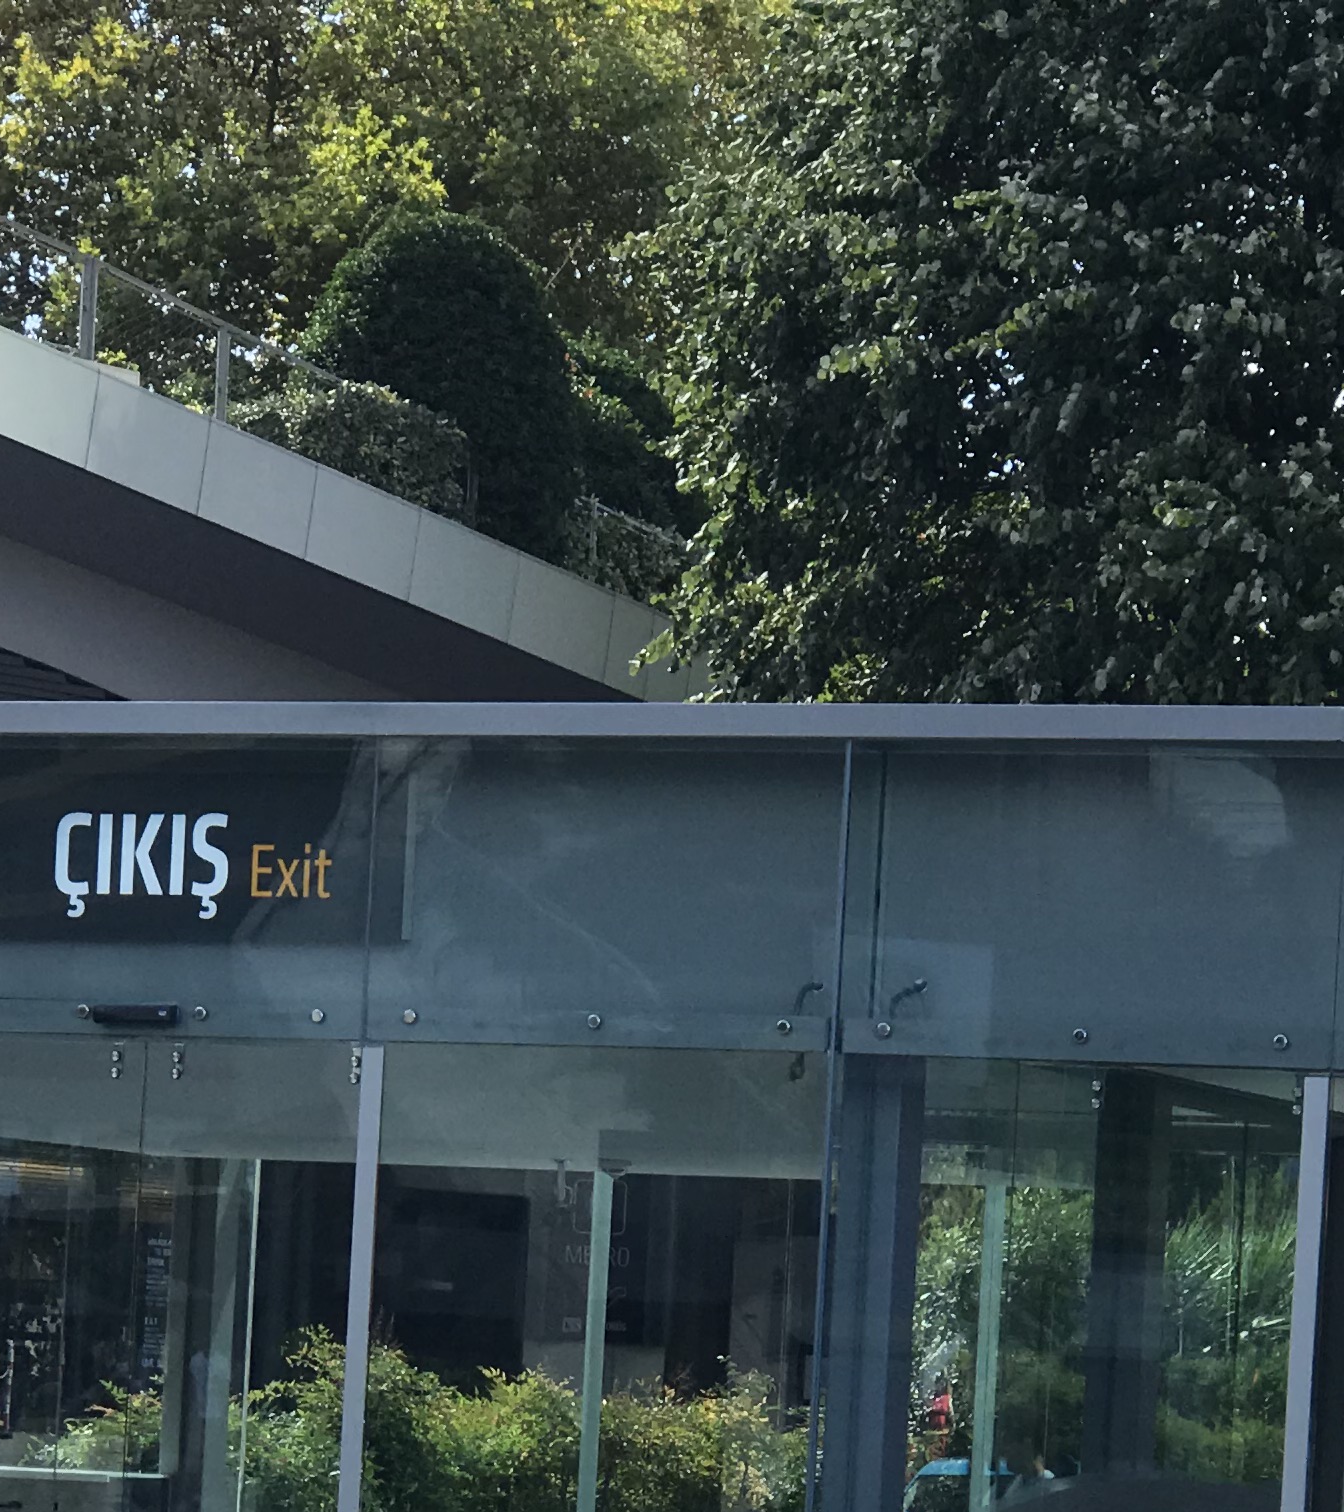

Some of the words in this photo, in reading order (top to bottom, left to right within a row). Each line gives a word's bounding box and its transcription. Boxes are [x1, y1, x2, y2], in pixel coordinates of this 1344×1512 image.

[55, 812, 229, 919] ÇIKIŞ
[250, 843, 332, 899] Exit
[565, 1245, 630, 1268] MERO
